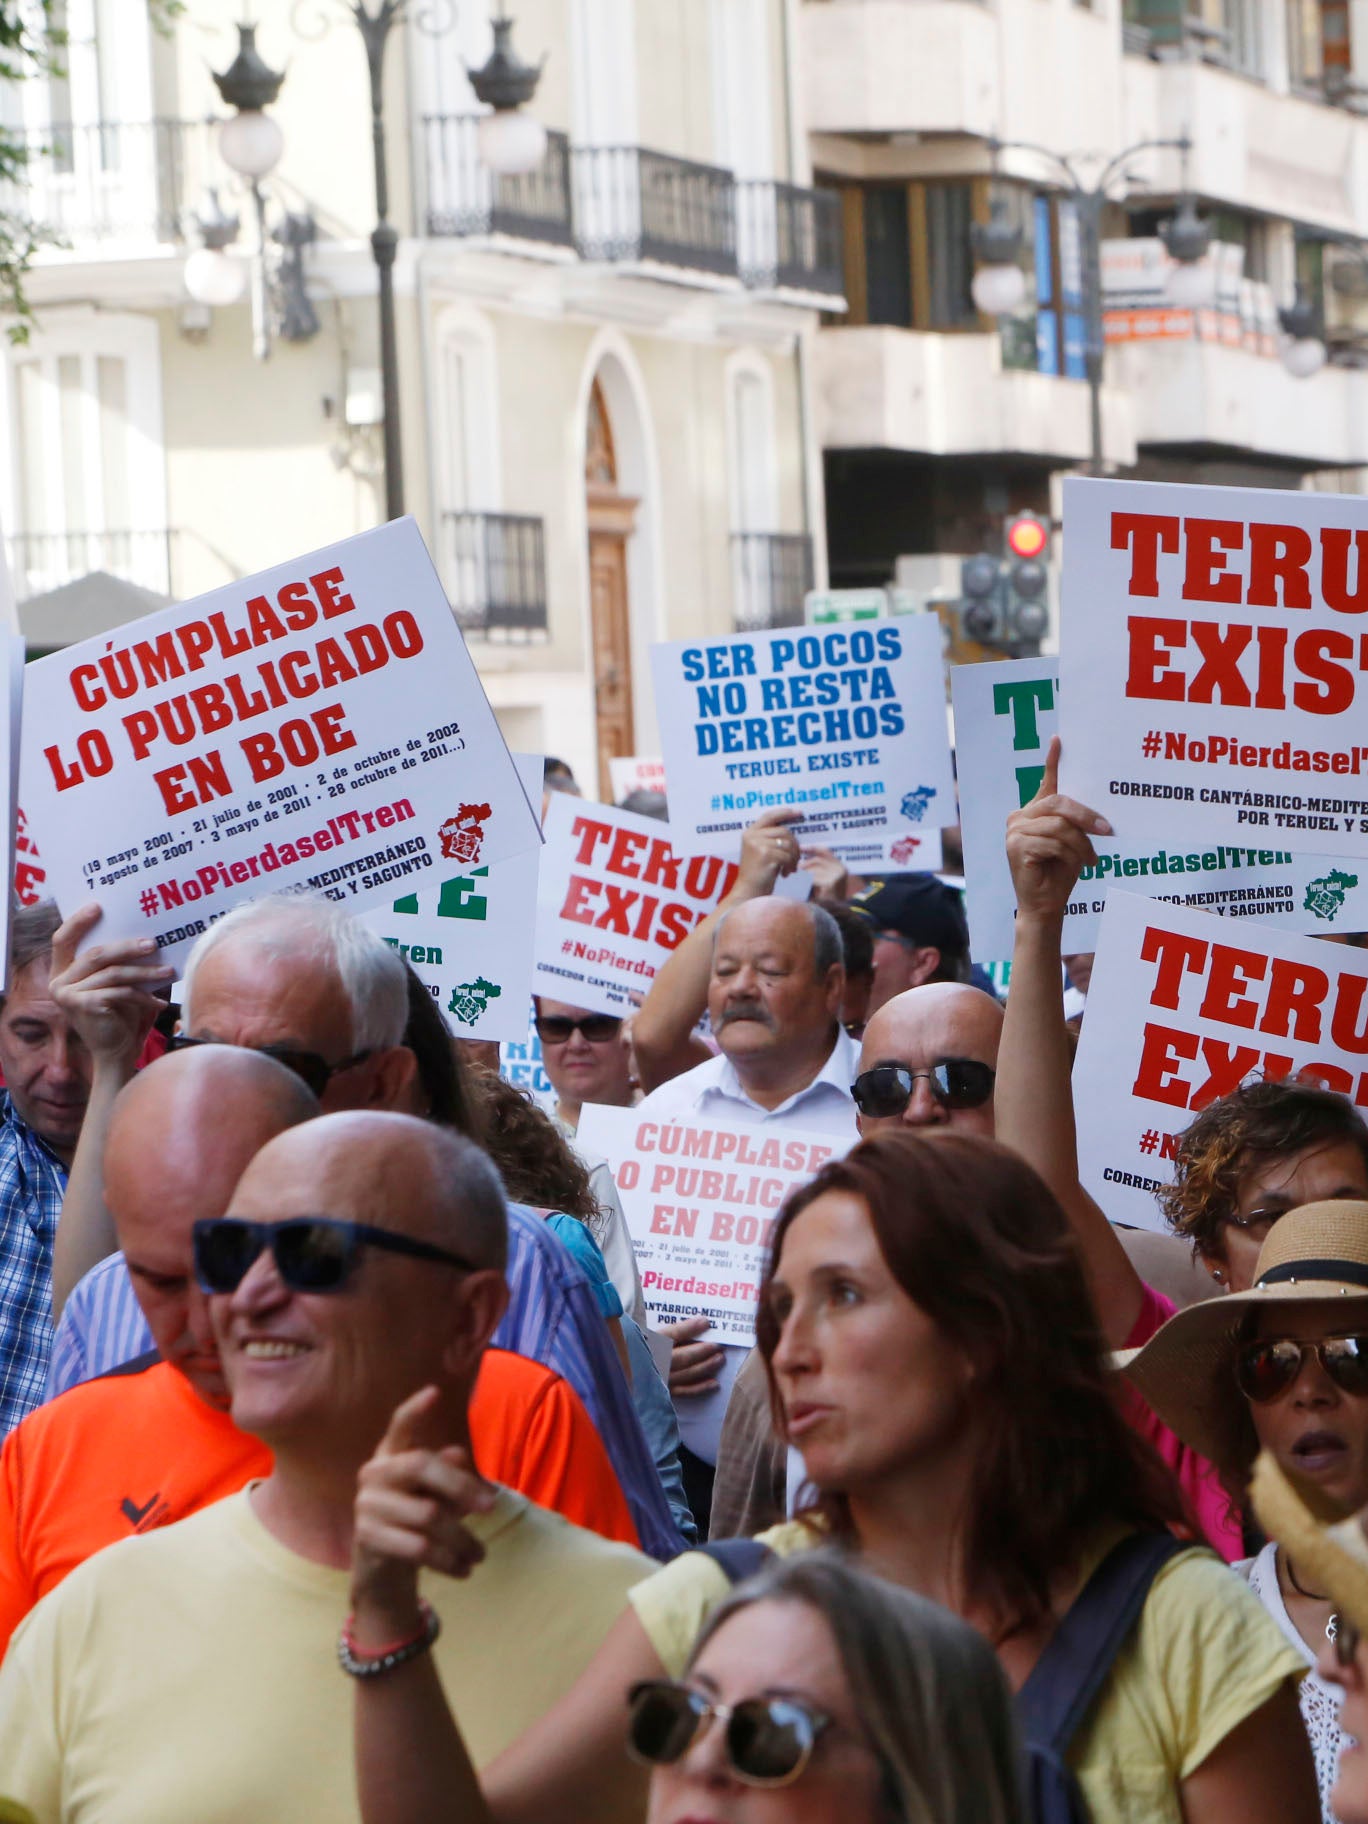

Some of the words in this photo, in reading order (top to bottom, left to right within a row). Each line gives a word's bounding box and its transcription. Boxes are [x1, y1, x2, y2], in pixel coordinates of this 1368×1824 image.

[69, 566, 356, 712] CÚMPLASE
[682, 643, 757, 682] SER
[770, 627, 903, 673] POCOS
[43, 728, 114, 792] LO
[121, 610, 424, 761] PUBLICADO
[696, 682, 747, 718] NO
[760, 666, 896, 712] RESTA
[694, 703, 905, 756] DERECHOS
[153, 750, 233, 816] EN
[239, 703, 357, 783] BOE
[725, 757, 800, 780] TERUEL
[808, 748, 880, 772] EXISTE
[82, 859, 101, 877] (19
[106, 847, 139, 866] mayo
[143, 832, 174, 851] 2001
[192, 818, 208, 833] 21
[212, 807, 241, 828] julio
[246, 800, 262, 812] de
[267, 784, 298, 804] 2001
[316, 773, 327, 786] 2
[332, 764, 348, 779] de
[353, 743, 401, 772] octubre
[406, 738, 422, 752] de
[426, 722, 460, 744] 2002
[711, 781, 885, 812] #NoPierdaselTren
[1109, 780, 1195, 802] CORREDOR
[86, 878, 95, 890] 7
[99, 864, 139, 886] agosto
[142, 854, 159, 869] de
[162, 840, 193, 861] 2007
[210, 830, 221, 842] 3
[225, 817, 259, 837] mayo
[264, 809, 280, 823] de
[283, 796, 311, 815] 2011
[327, 782, 346, 798] 28
[350, 764, 397, 790] octubre
[401, 755, 417, 770] de
[842, 816, 887, 830] SAGUNTO
[1237, 810, 1271, 827] POR
[1274, 812, 1340, 834] TERUEL
[1343, 819, 1355, 833] Y
[138, 798, 417, 918] #NoPierdaselTren
[347, 881, 358, 895] Y
[362, 852, 433, 890] SAGUNTO
[570, 815, 740, 905] TERU
[559, 873, 709, 951] EXIS
[1229, 900, 1294, 917] SAGUNTO
[155, 919, 206, 949] REDOR
[561, 938, 656, 978] #NoPierda
[635, 1118, 832, 1174] CÚMPLASE
[651, 1164, 798, 1209] PUBLIC
[1103, 1168, 1161, 1193] CORRED
[649, 1204, 700, 1238] EN
[657, 1314, 677, 1325] POR
